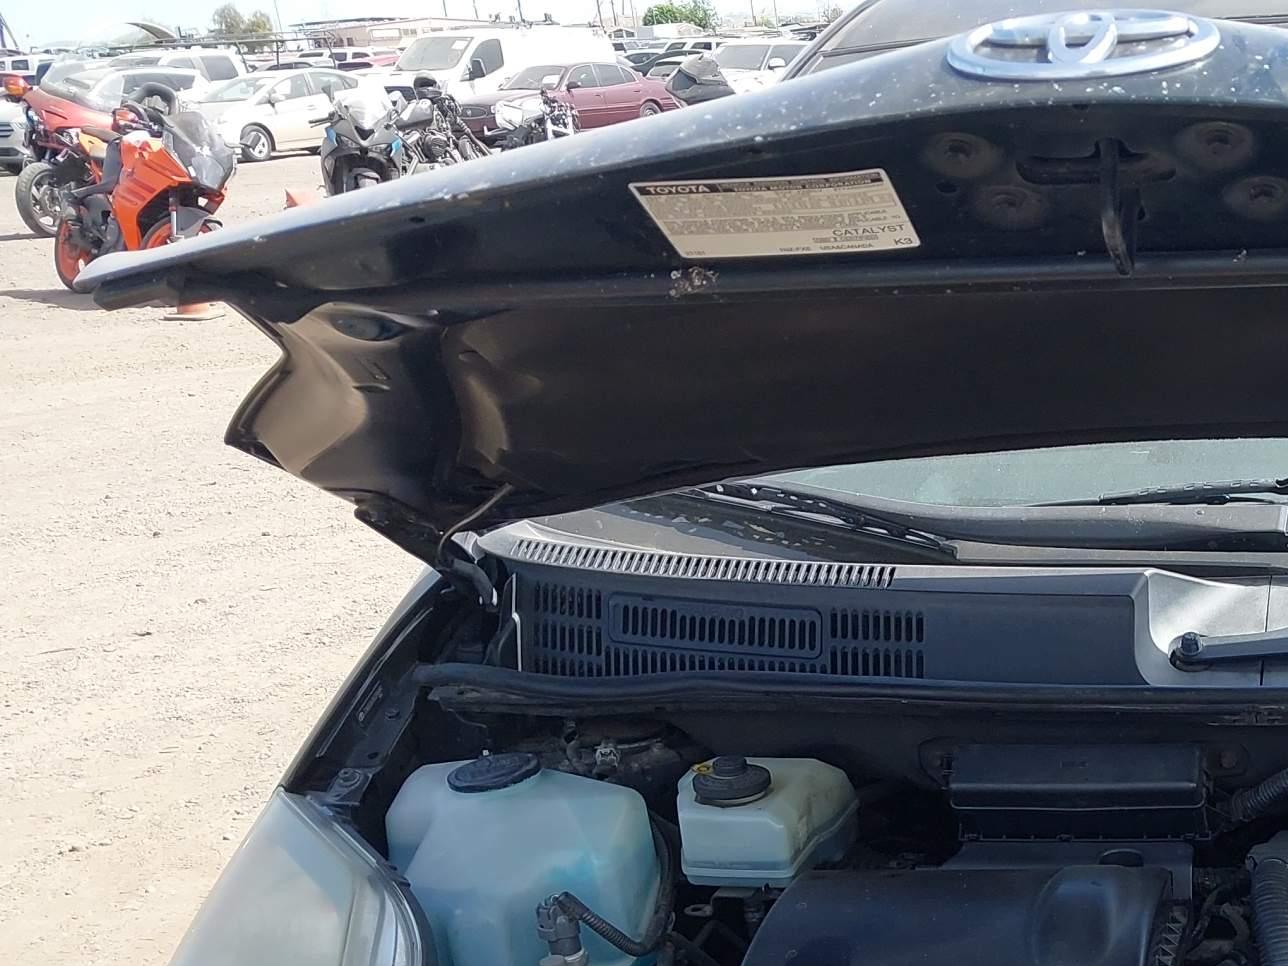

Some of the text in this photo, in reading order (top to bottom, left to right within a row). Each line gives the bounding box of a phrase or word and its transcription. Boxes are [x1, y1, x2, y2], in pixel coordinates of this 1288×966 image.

[645, 184, 711, 195] TOYOTA
[832, 223, 905, 237] CATALYST
[893, 237, 913, 246] K3
